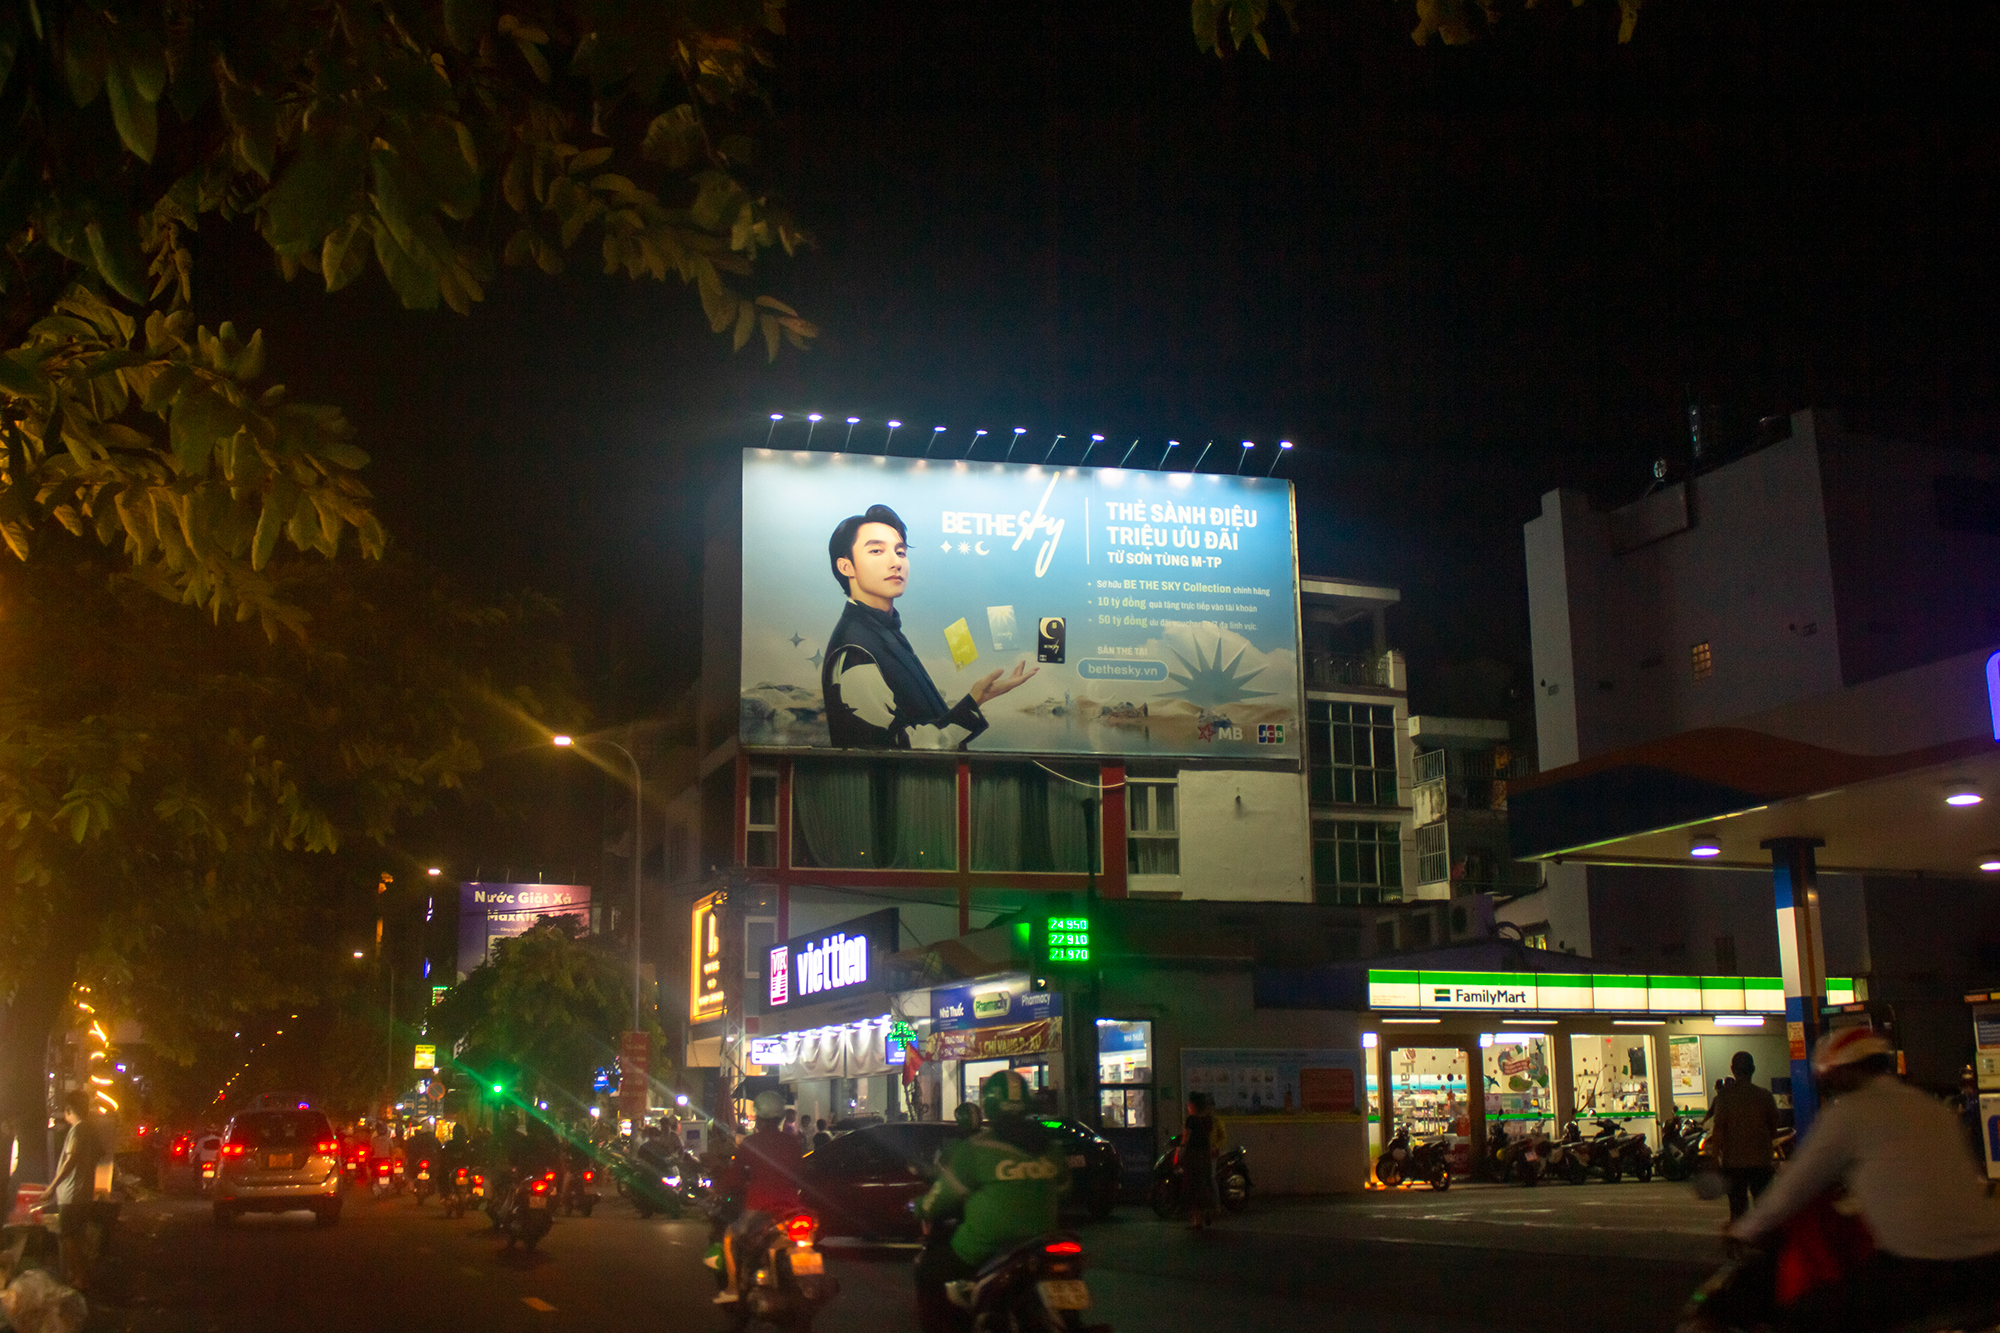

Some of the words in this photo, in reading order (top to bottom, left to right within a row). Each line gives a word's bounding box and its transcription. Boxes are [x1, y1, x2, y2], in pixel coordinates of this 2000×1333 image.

[1105, 498, 1147, 522] THẺ
[1150, 500, 1206, 525] SÀNH
[1209, 504, 1258, 531] ĐIỆU
[1106, 523, 1168, 550] TRIỆU
[1172, 525, 1200, 549] ƯU
[1204, 527, 1238, 551] ĐÃI
[1107, 549, 1125, 564] TỪ
[1126, 551, 1153, 565] SƠN
[1155, 552, 1189, 567] TÙNG
[1191, 555, 1222, 568] M-TP
[1124, 580, 1137, 589] BE
[1139, 580, 1159, 590] THE
[1161, 581, 1181, 591] SKY
[1183, 582, 1231, 593] Collection
[1098, 596, 1109, 606] 10
[1122, 595, 1146, 610] đồng
[1099, 615, 1110, 625] 50
[1124, 613, 1148, 628] đồng
[1088, 663, 1158, 678] bethesky.vn
[1218, 727, 1243, 741] MB
[474, 890, 515, 904] Nước
[518, 891, 549, 907] Giặt
[796, 932, 868, 996] viettien
[1021, 993, 1051, 1007] Pharmacy
[1455, 988, 1526, 1005] FamilyMart
[995, 1157, 1059, 1180] Grab
